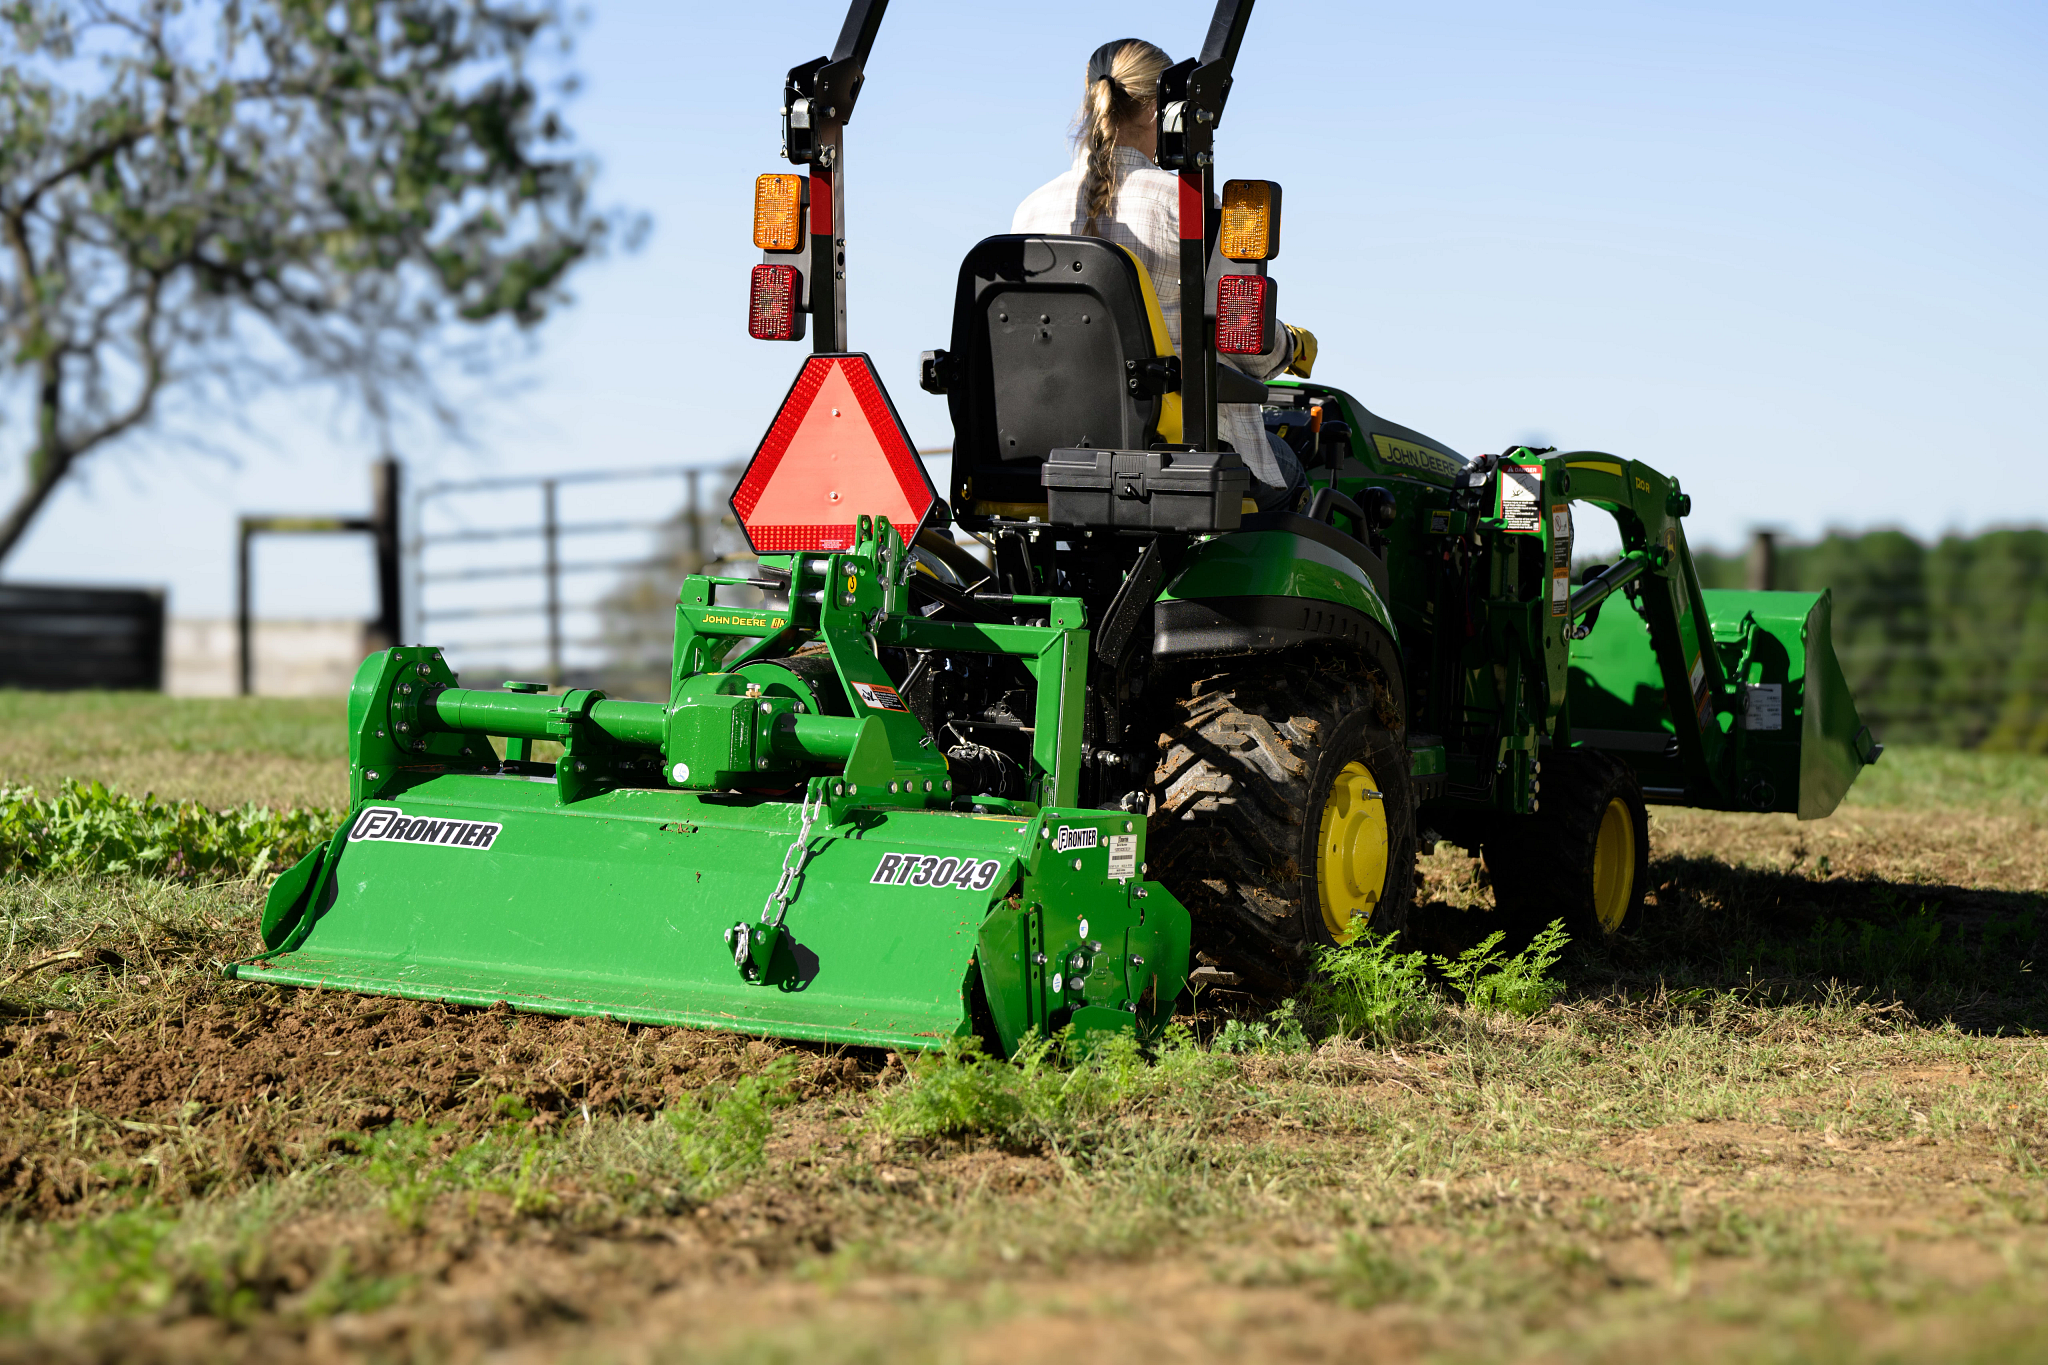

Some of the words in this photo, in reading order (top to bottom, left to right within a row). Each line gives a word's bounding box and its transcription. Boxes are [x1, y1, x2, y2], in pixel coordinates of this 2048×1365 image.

[1387, 443, 1419, 466] JOHN
[1419, 450, 1457, 476] DEERE
[702, 613, 730, 625] JOHN
[731, 616, 767, 627] DEERE
[351, 809, 499, 848] FRONTIER
[1058, 827, 1097, 851] FRONTIER
[872, 854, 999, 890] RT3049
